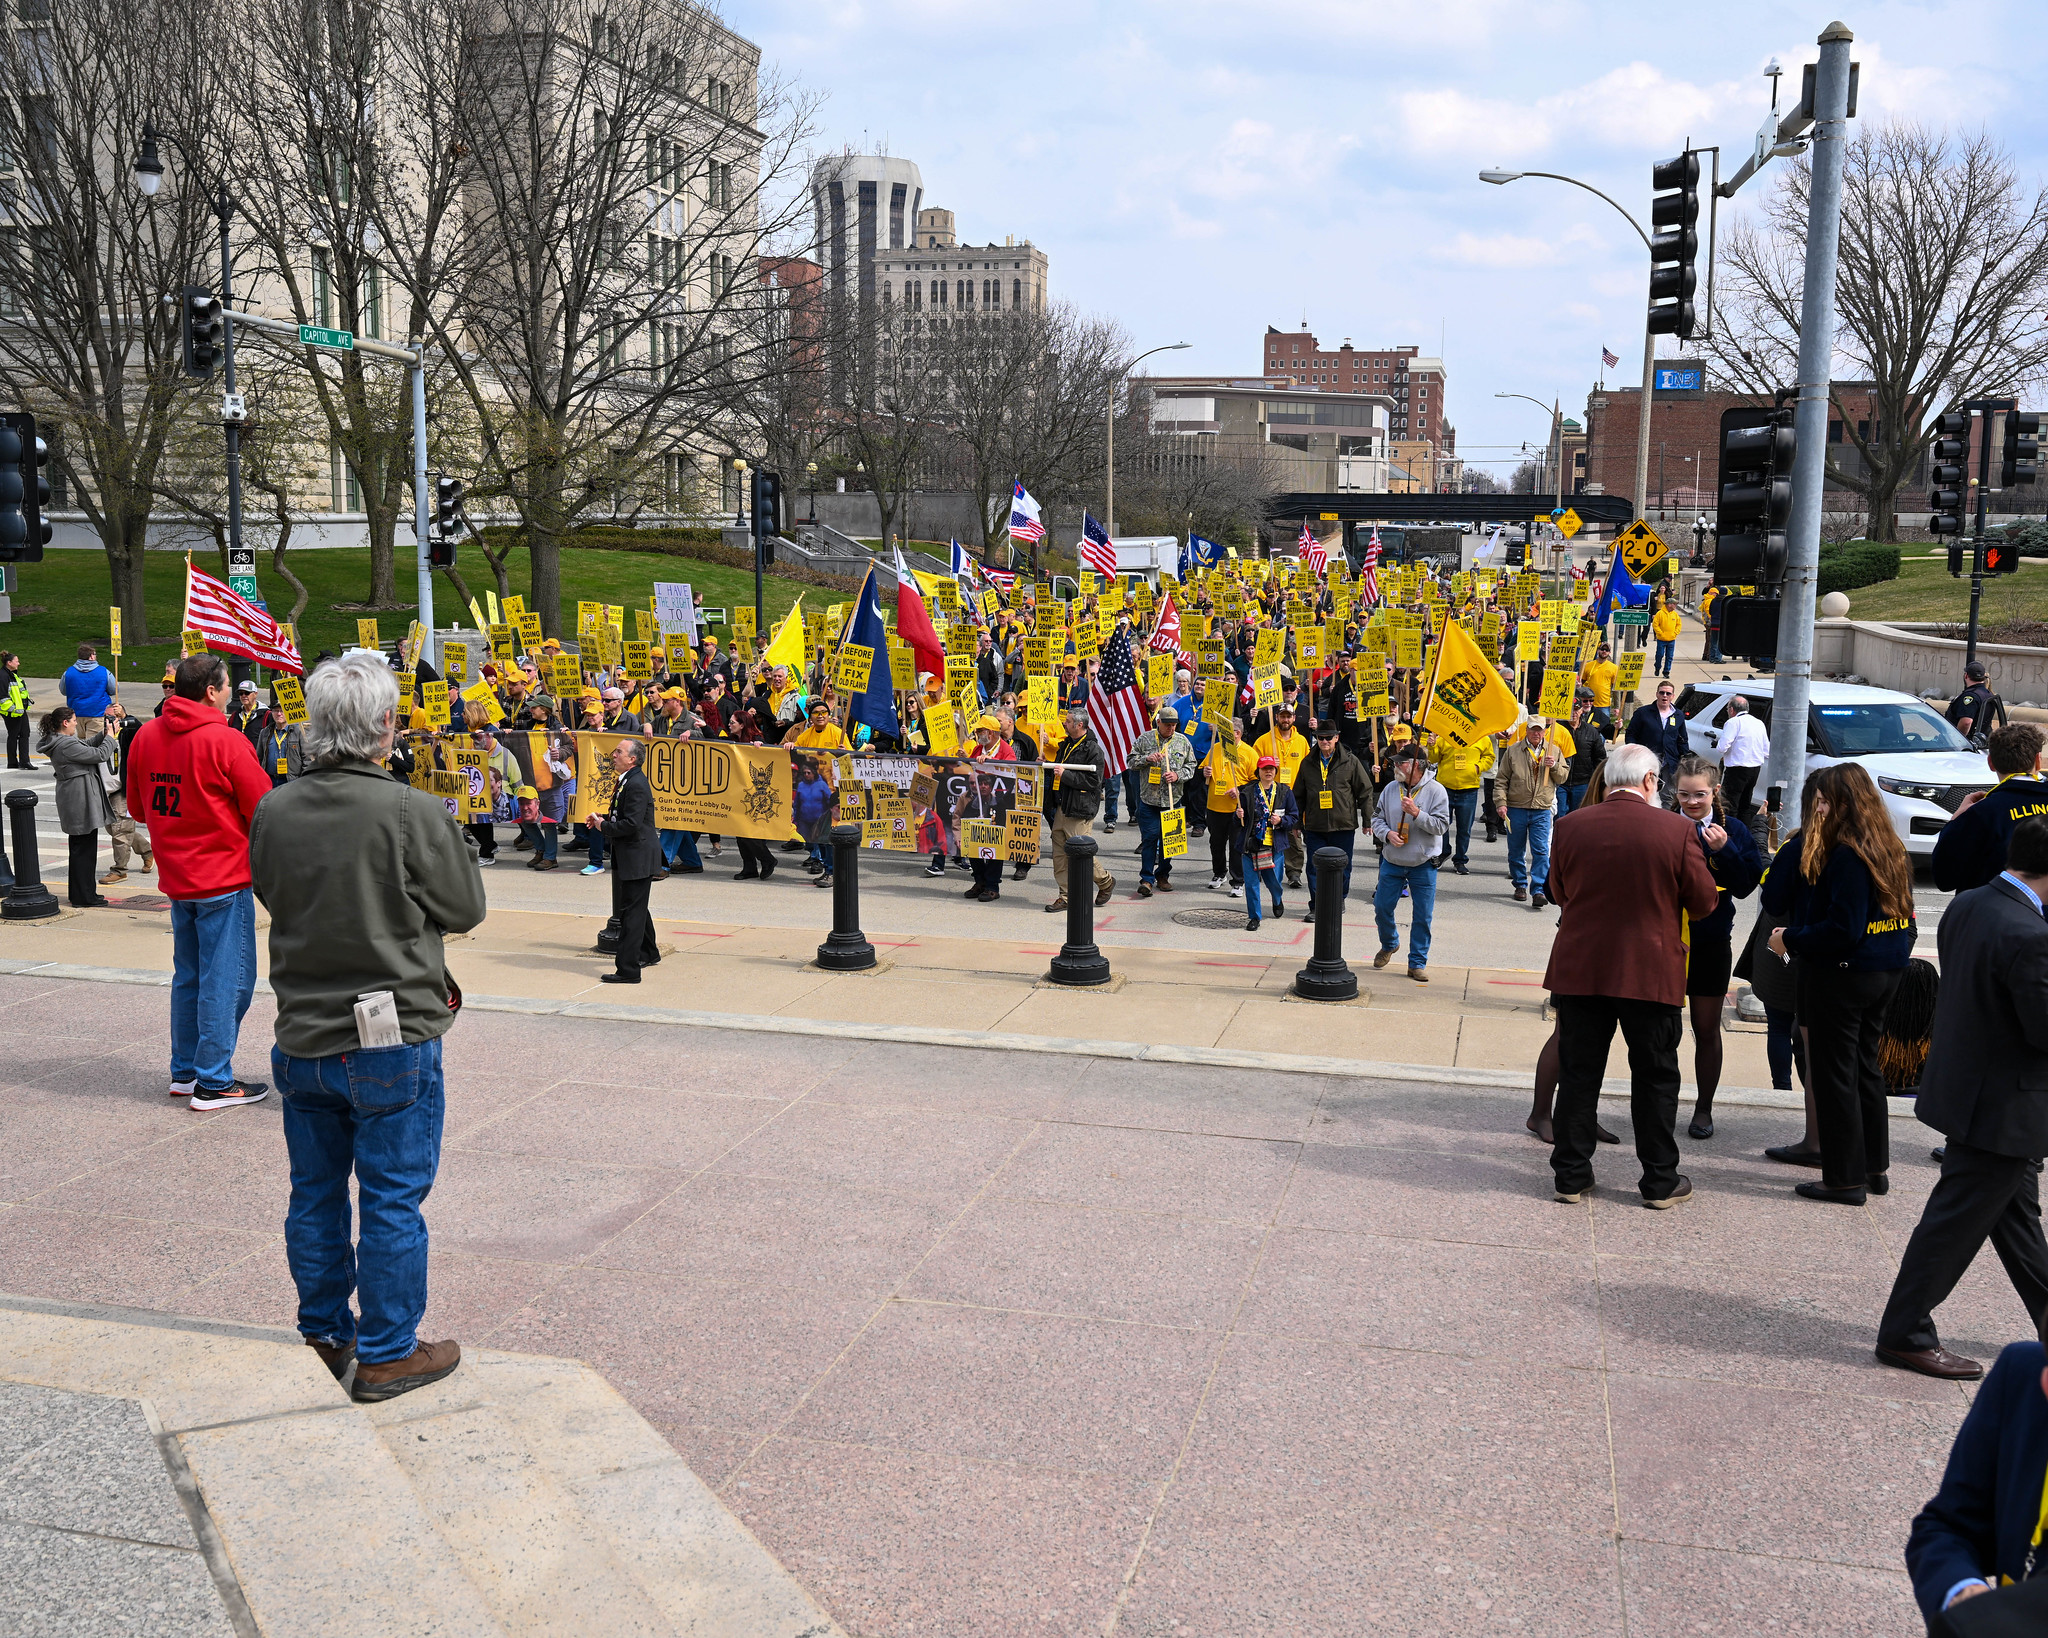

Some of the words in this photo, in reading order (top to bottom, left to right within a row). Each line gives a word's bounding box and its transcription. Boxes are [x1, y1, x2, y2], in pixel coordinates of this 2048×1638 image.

[304, 328, 330, 343] CAPITOL
[338, 334, 348, 346] AVE
[667, 585, 688, 596] HAVE
[658, 596, 669, 607] THE
[672, 598, 690, 609] RIGHT
[668, 609, 683, 620] TO
[660, 620, 694, 633] PROTECT
[1076, 623, 1094, 633] WE'RE
[1080, 632, 1092, 640] NOT
[444, 644, 466, 653] PROFILING
[1077, 640, 1096, 650] GOING
[1198, 641, 1223, 652] CRIME
[845, 646, 872, 659] BEFORE
[1080, 647, 1096, 658] AWAY
[843, 658, 855, 666] MORE
[858, 661, 870, 670] LAWS
[947, 658, 968, 666] WE'RE
[1027, 660, 1049, 668] GOING
[844, 669, 864, 679] FIX
[1198, 664, 1223, 674] MAGNET
[1360, 671, 1383, 681] ILLINOIS
[276, 680, 297, 691] WE'RE
[434, 684, 446, 692] WOKE
[839, 678, 849, 686] OLD
[850, 680, 866, 690] FLAWS
[1358, 682, 1388, 692] ENDANGERED
[283, 691, 297, 700] NOT
[1258, 689, 1280, 706] SAFETY
[284, 701, 305, 711] GOING
[1363, 706, 1386, 716] SPECIES
[288, 710, 307, 721] AWAY
[1448, 712, 1460, 724] ON
[1459, 720, 1473, 734] ME
[457, 754, 480, 765] BAD
[891, 760, 916, 768] YOUR
[150, 772, 182, 784] SMITH
[433, 771, 468, 796] IMAGINARY
[839, 780, 864, 792] KILLING
[873, 784, 895, 793] WE'RE
[152, 786, 182, 817] 42
[675, 798, 697, 806] Owner
[700, 800, 720, 809] Lobby
[694, 809, 728, 819] Association
[841, 806, 866, 820] ZONES
[1163, 810, 1181, 822] SPECIES
[663, 815, 705, 824] igold.isra.org
[1010, 814, 1038, 827] WE'RE
[970, 824, 1004, 845] IMAGINARY
[1014, 827, 1033, 838] NOT
[1008, 840, 1036, 852] GOING
[1009, 851, 1034, 864] AWAY
